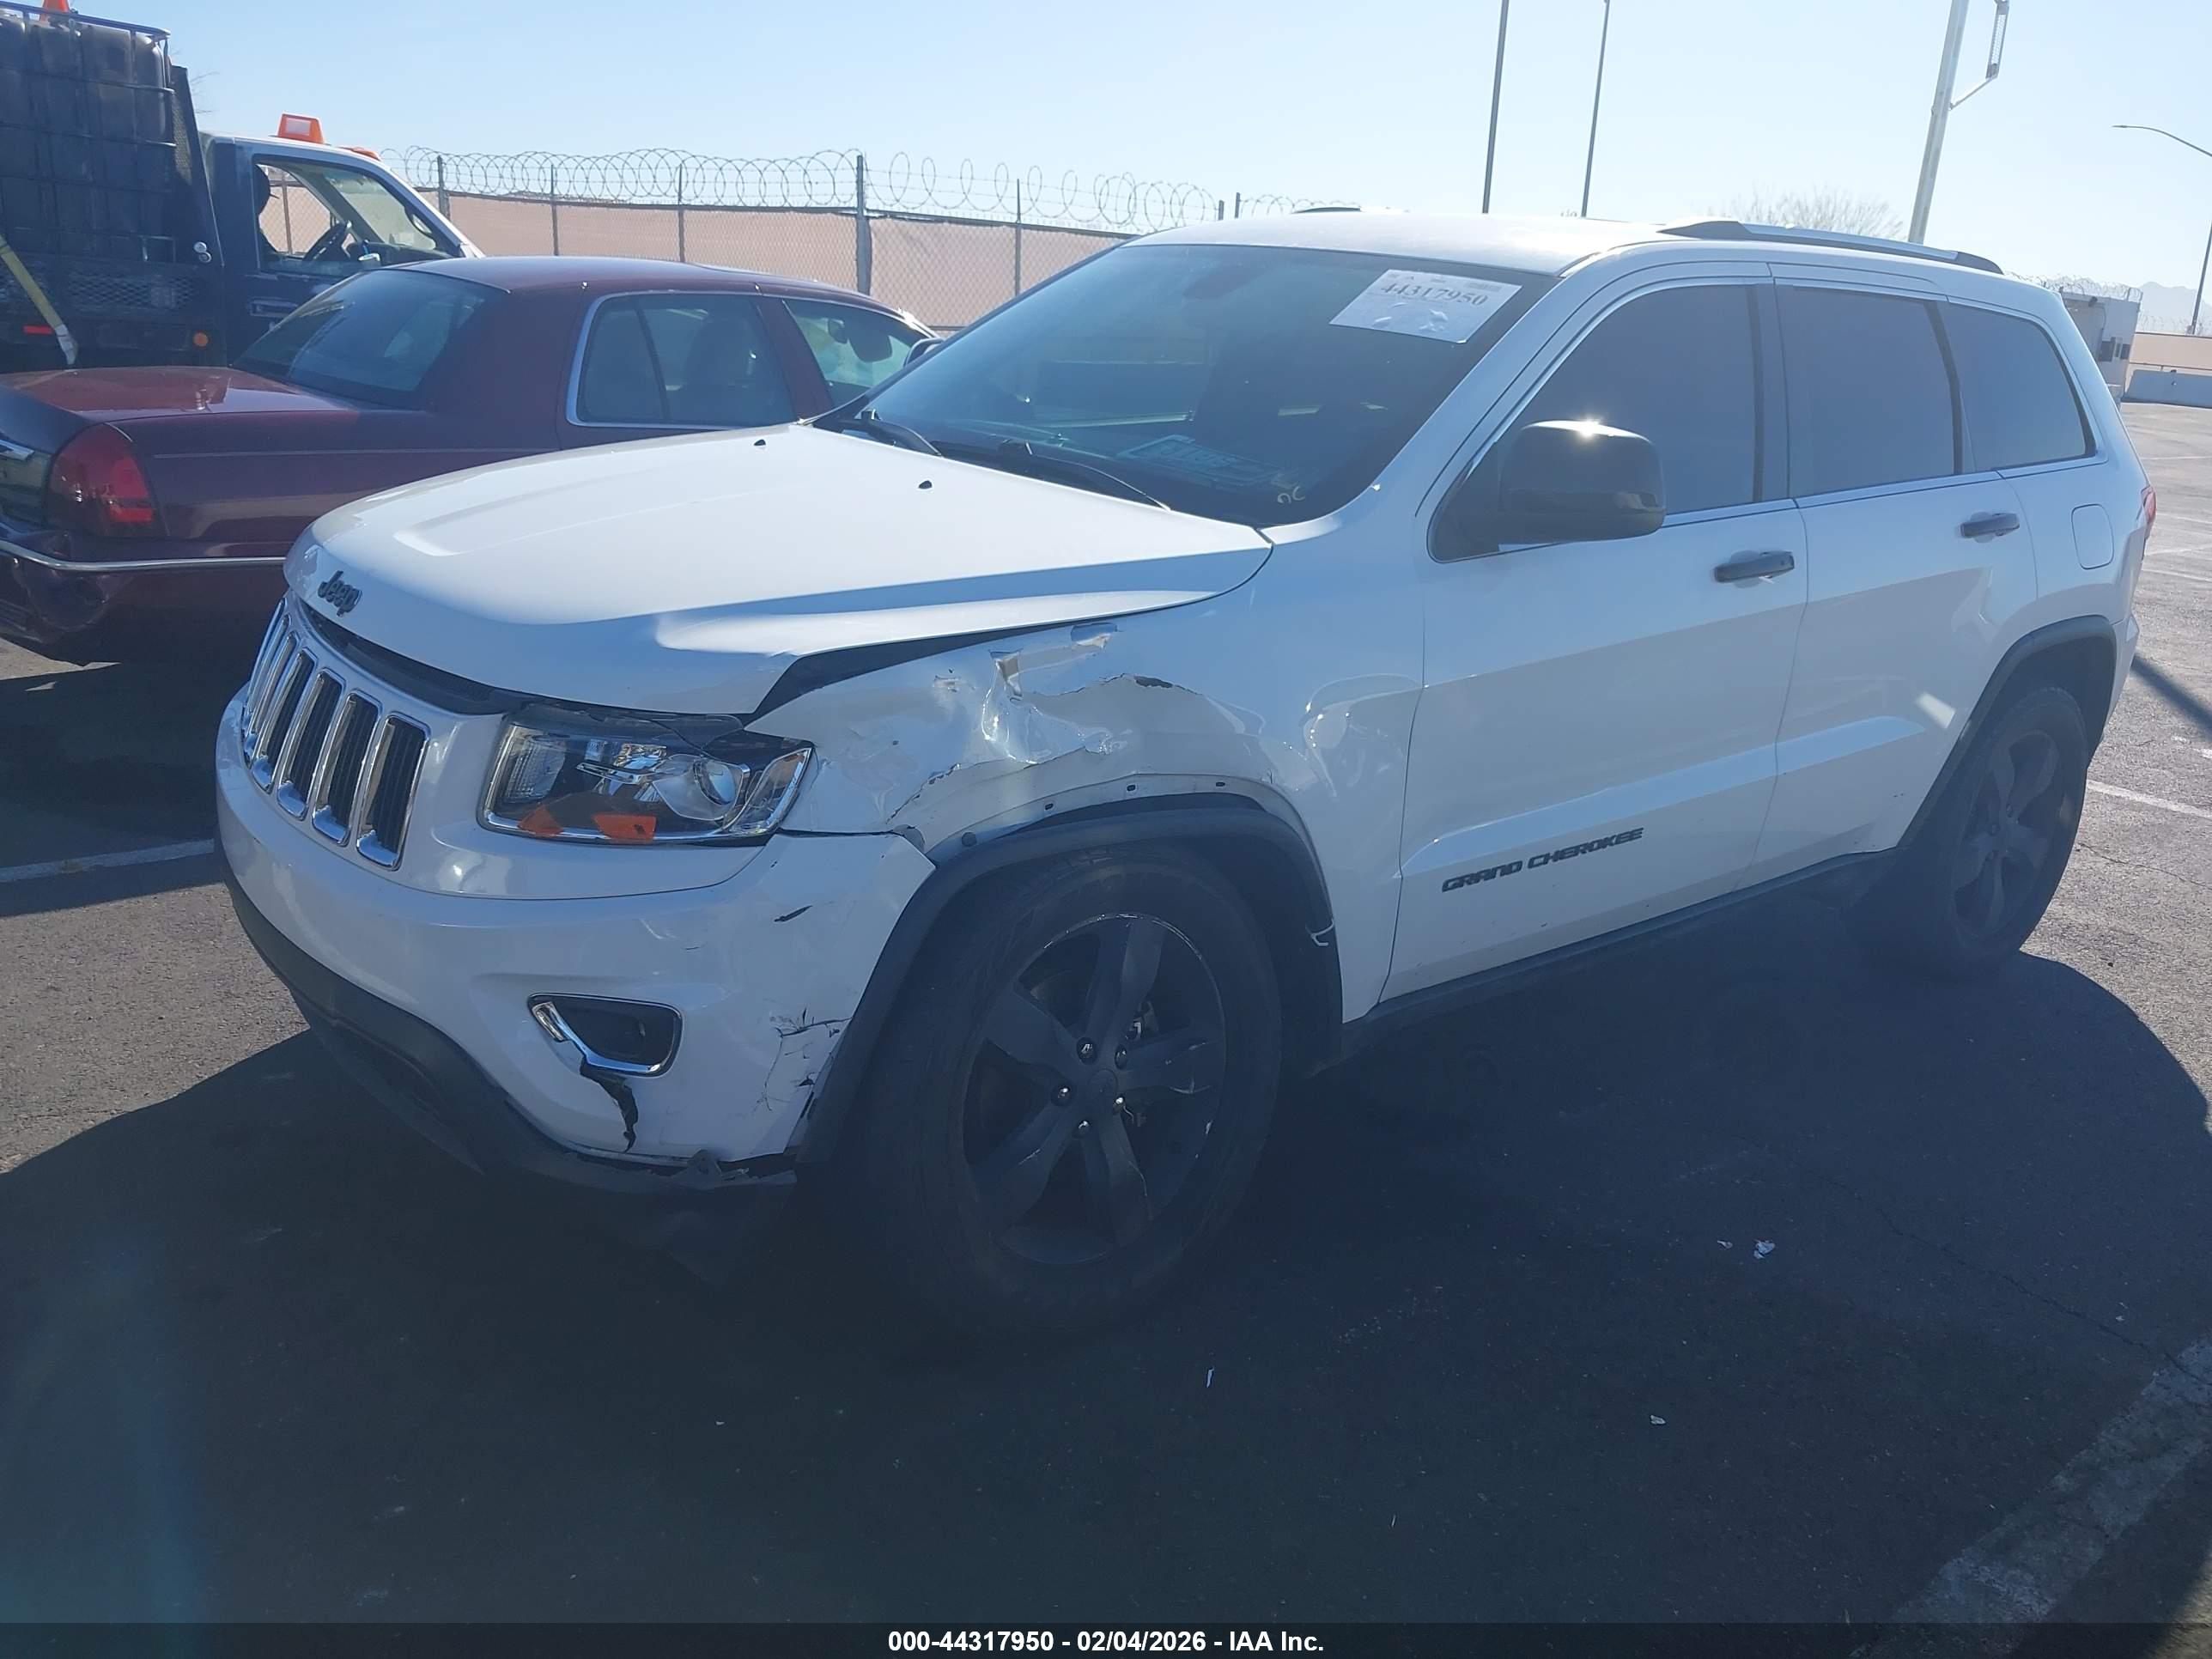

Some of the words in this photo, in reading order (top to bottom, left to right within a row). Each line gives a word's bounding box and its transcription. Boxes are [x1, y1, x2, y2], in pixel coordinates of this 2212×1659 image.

[1381, 283, 1489, 307] 44317950
[317, 570, 362, 617] Jeep
[1442, 860, 1522, 892] GRAND
[1527, 827, 1644, 869] CHEROKEE
